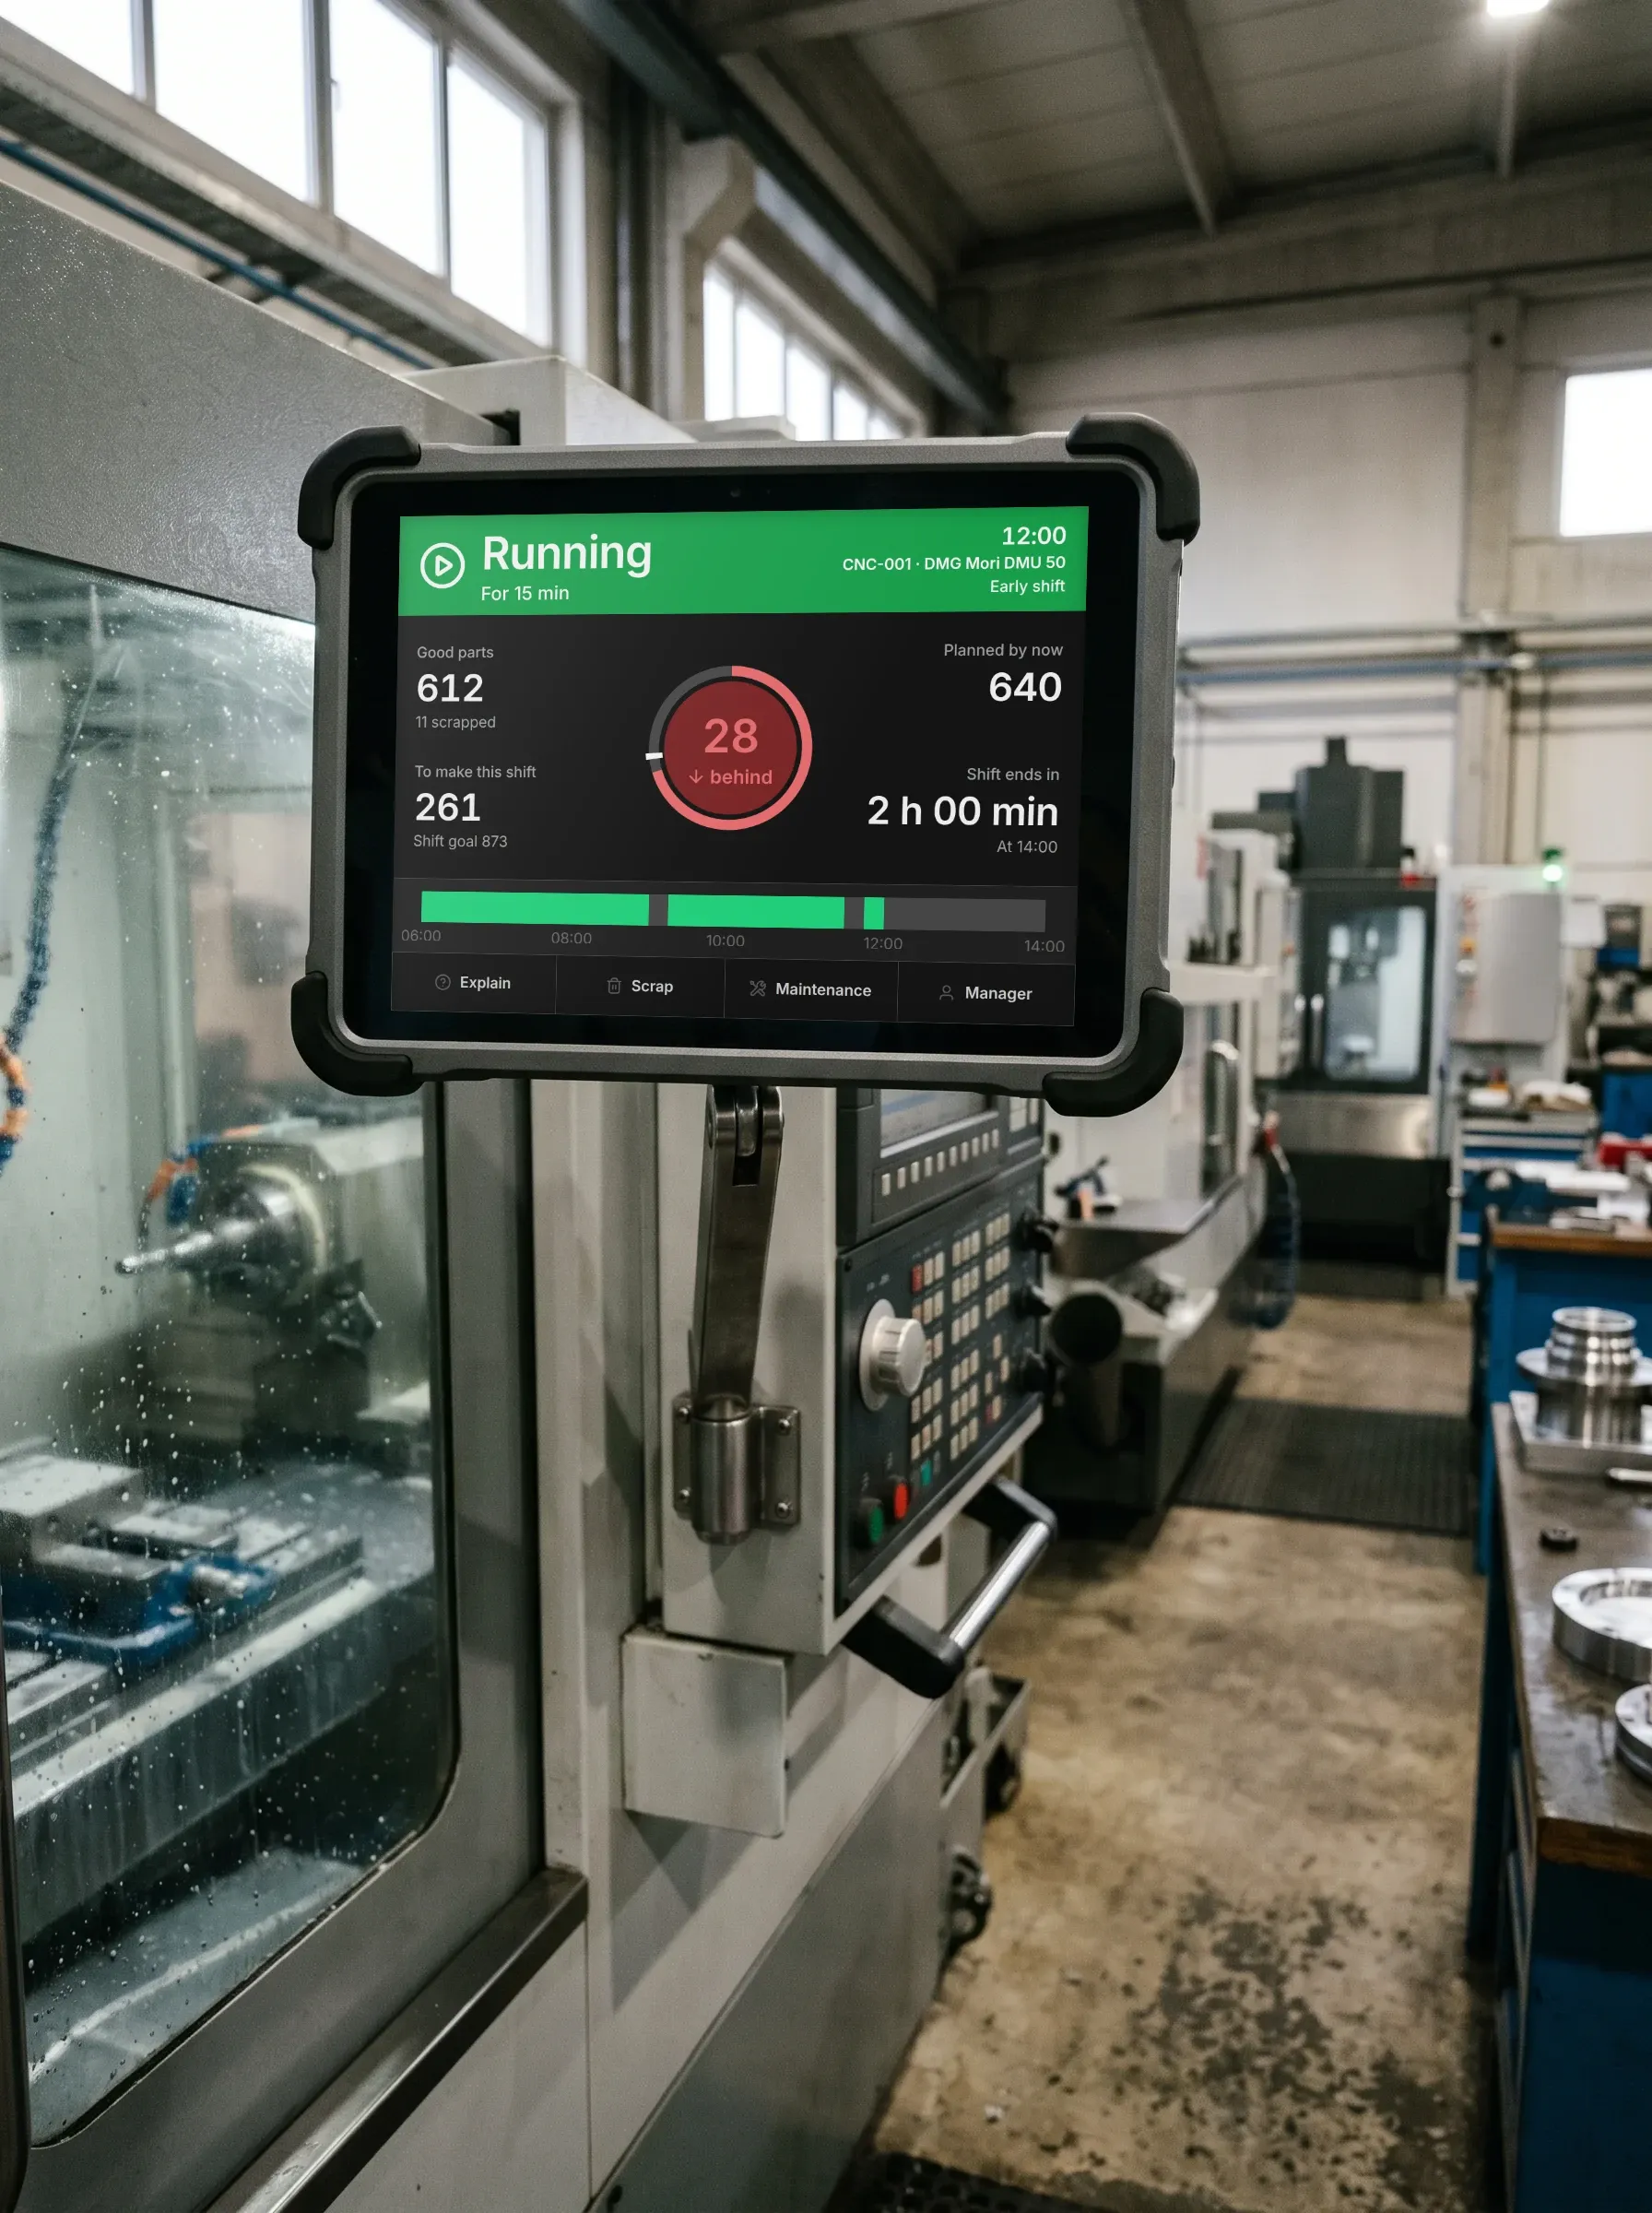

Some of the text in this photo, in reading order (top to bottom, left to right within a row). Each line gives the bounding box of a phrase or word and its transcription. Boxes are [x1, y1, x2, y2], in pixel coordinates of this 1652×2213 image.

[1002, 526, 1067, 546] 12:00
[483, 533, 652, 579] Running
[843, 557, 912, 572] CNC-001
[924, 556, 962, 571] DMG
[965, 556, 1000, 570] Mori
[1004, 556, 1042, 570] DMU
[1045, 555, 1067, 569] 50
[481, 585, 570, 601] For 15 min
[990, 578, 1066, 596] Early shift
[417, 645, 494, 662] Good parts
[944, 643, 1064, 660] Planned by now
[417, 673, 483, 703] 612
[989, 671, 1062, 703] 640
[415, 716, 496, 731] 11 scrapped
[704, 717, 758, 753] 28
[414, 764, 537, 778] To make this shift
[710, 768, 773, 785] behind
[966, 767, 1060, 781] Shift ends in
[416, 792, 481, 822] 261
[867, 795, 1058, 826] 2 h 00 min
[413, 834, 508, 850] Shift goal 873
[997, 839, 1058, 854] At 14:00
[401, 929, 442, 941] 06:00
[551, 931, 593, 944] 08:00
[706, 934, 746, 947] 10:00
[863, 937, 903, 950] 12:00
[1024, 940, 1066, 953] 14:00
[460, 976, 511, 992] Explain
[631, 979, 674, 996] Scrap
[775, 982, 872, 997] Maintenance
[965, 986, 1033, 1003] Manager
